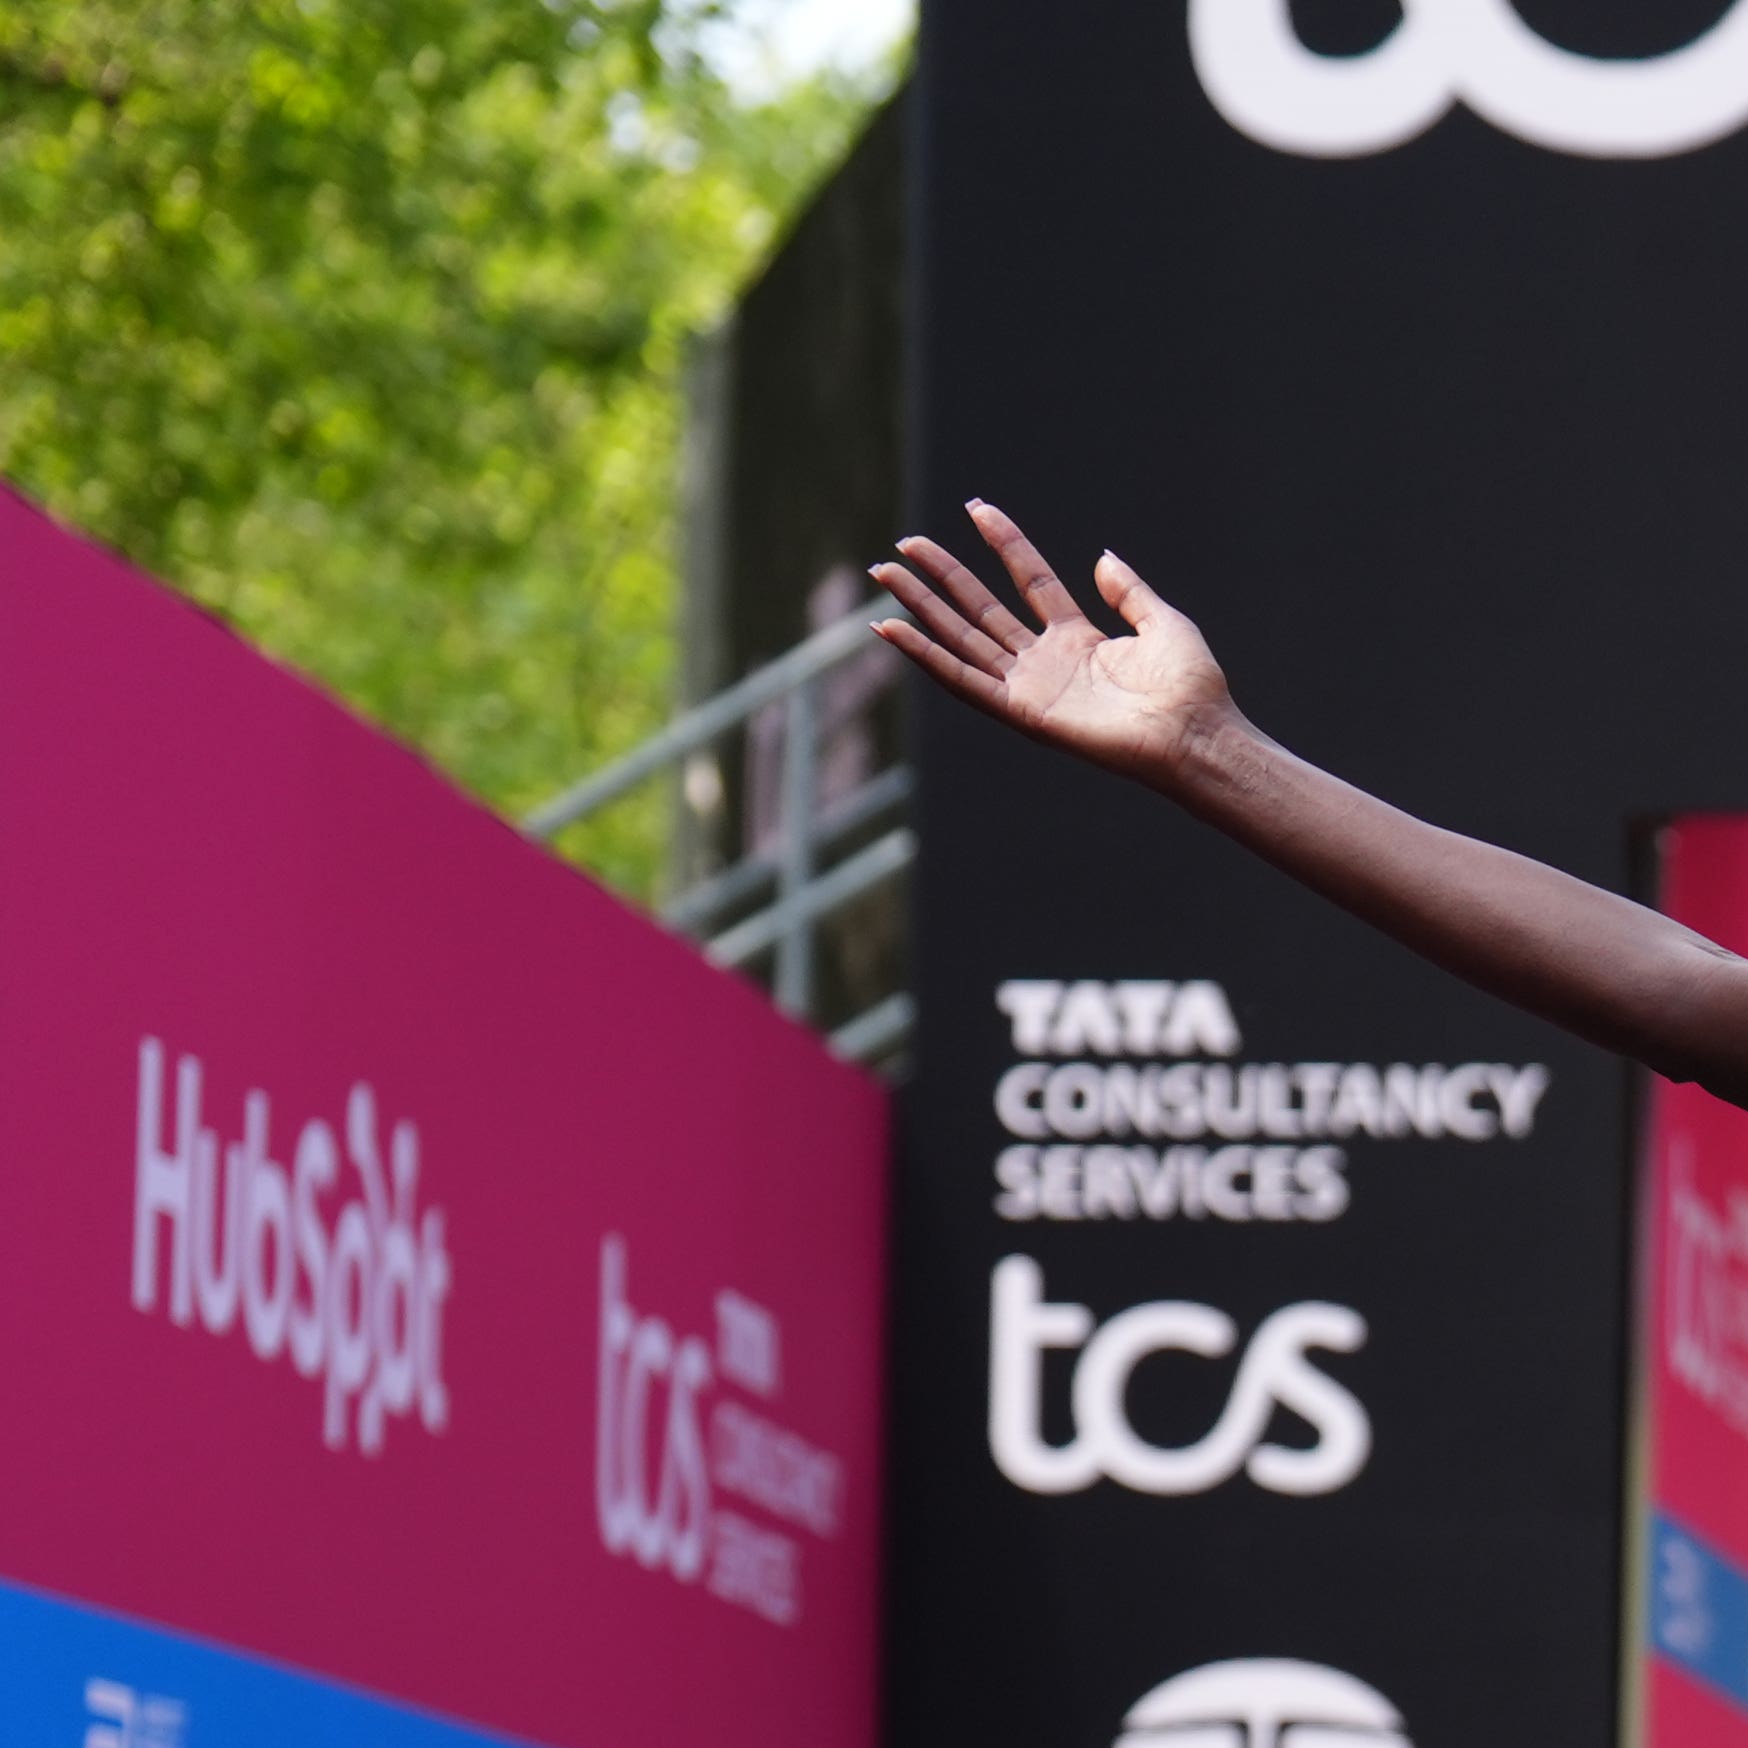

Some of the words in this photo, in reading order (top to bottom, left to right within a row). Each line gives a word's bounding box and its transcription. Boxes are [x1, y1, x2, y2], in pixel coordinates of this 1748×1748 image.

[996, 978, 1241, 1057] TATA
[994, 1062, 1549, 1141] CONSULTANCY
[994, 1143, 1351, 1221] SERVICES
[988, 1253, 1372, 1495] tcs
